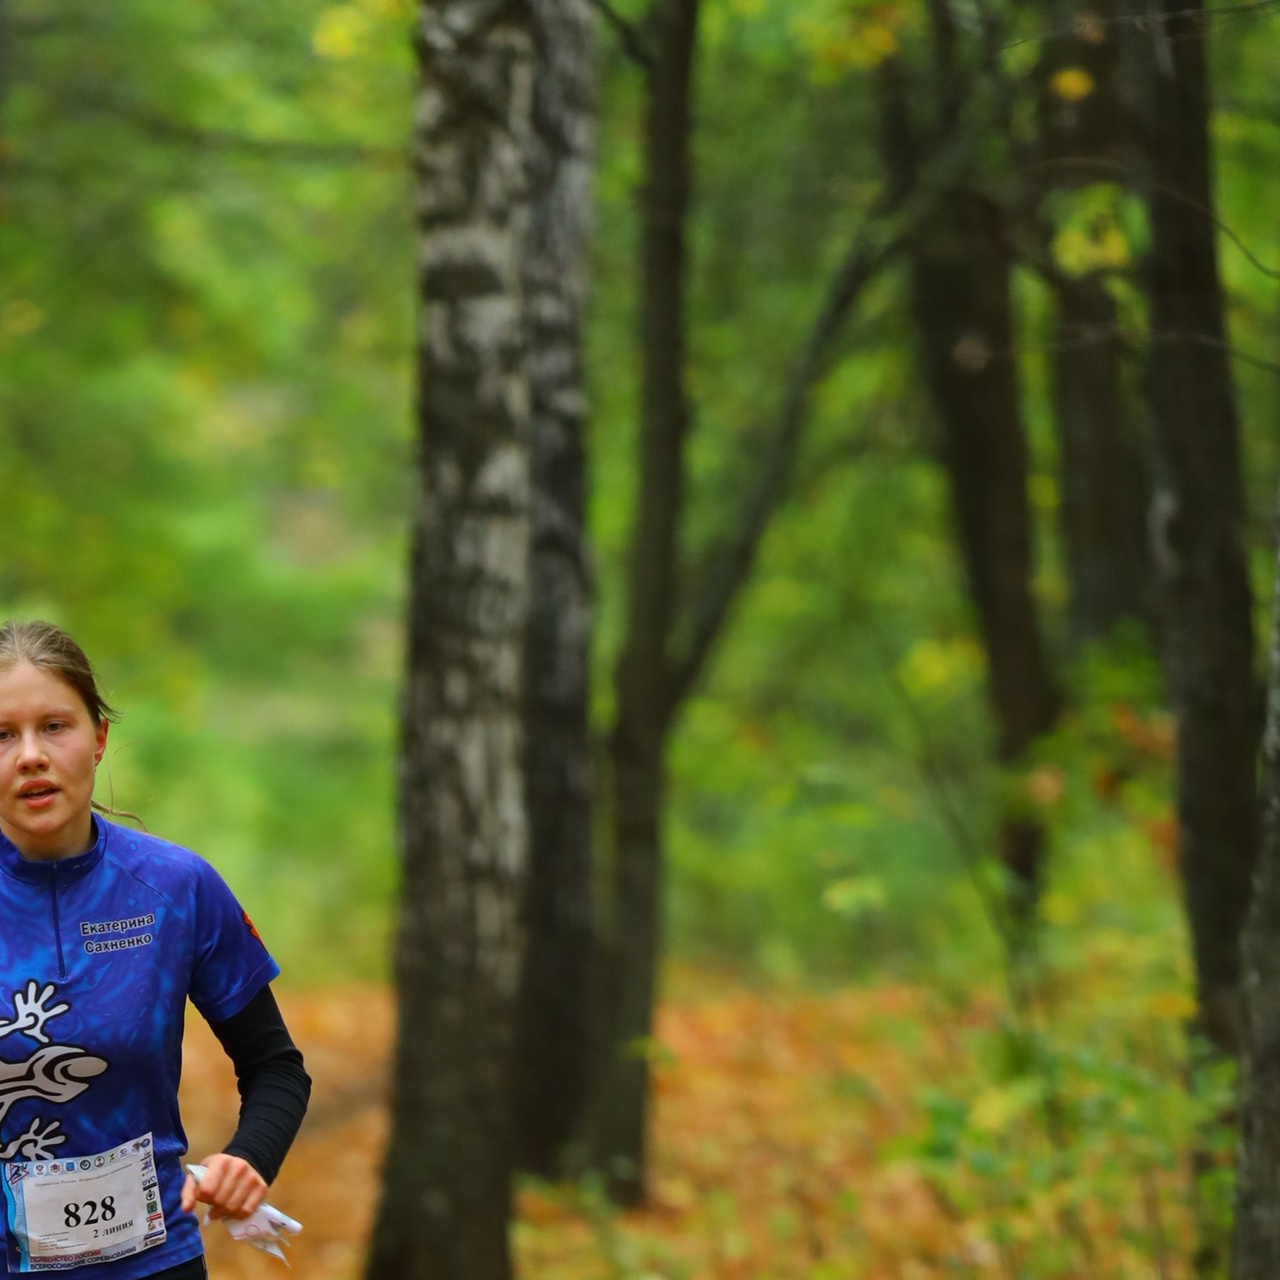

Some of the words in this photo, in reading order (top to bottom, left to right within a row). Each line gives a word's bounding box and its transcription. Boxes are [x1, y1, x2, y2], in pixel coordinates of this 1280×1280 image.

[80, 914, 155, 936] Екатерина
[84, 934, 152, 954] Сахненко
[63, 1195, 116, 1228] 828
[93, 1229, 99, 1239] 2
[102, 1220, 133, 1237] линия
[75, 1249, 100, 1260] РОССИИ
[87, 1246, 136, 1263] СОРЕВНОВАНИЯ
